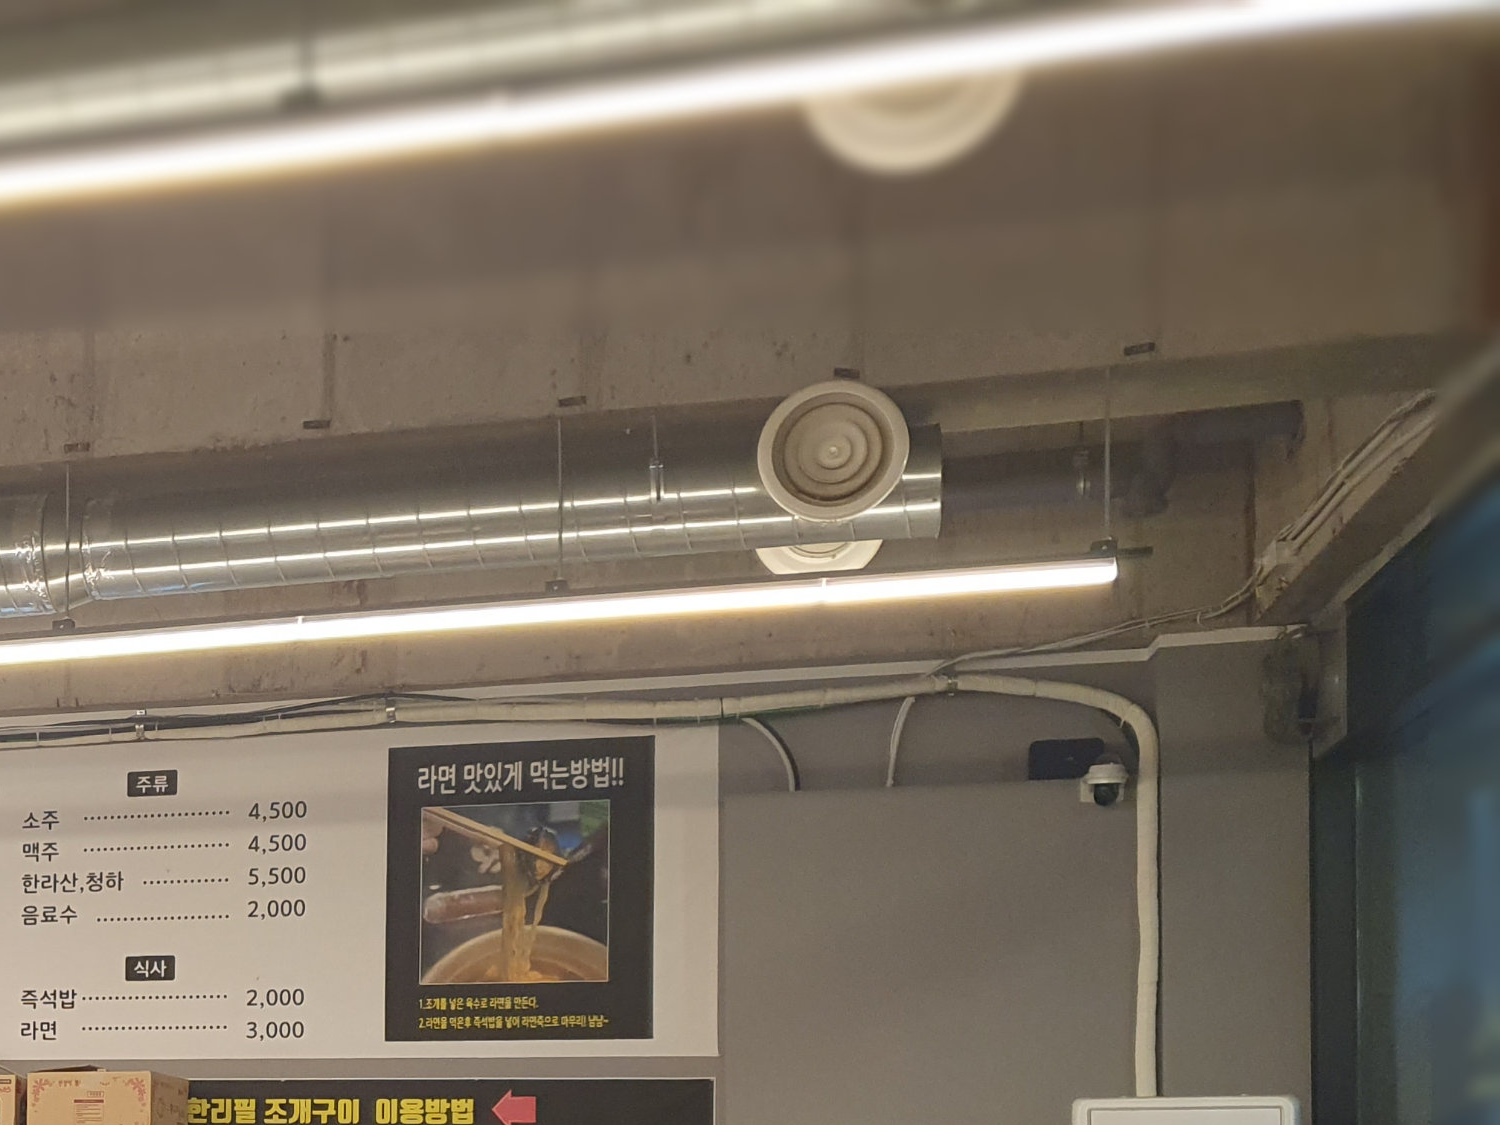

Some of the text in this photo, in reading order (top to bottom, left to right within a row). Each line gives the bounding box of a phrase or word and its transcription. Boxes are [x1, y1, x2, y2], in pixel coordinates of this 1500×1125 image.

[136, 775, 169, 793] 주류
[418, 756, 624, 795] 라면 맛있게 먹는방법!!
[22, 801, 308, 830] 소주 4,500
[22, 833, 307, 862] 맥주 4,500
[21, 866, 306, 894] 한라산,청하 5,500
[21, 899, 306, 926] 음료수 2,000
[134, 960, 167, 978] 식사
[20, 988, 305, 1010] 즉석밥 2,000
[20, 1021, 305, 1042] 라면 3,000
[263, 1098, 360, 1125] 조개구이
[375, 1098, 475, 1125] 이용방법
